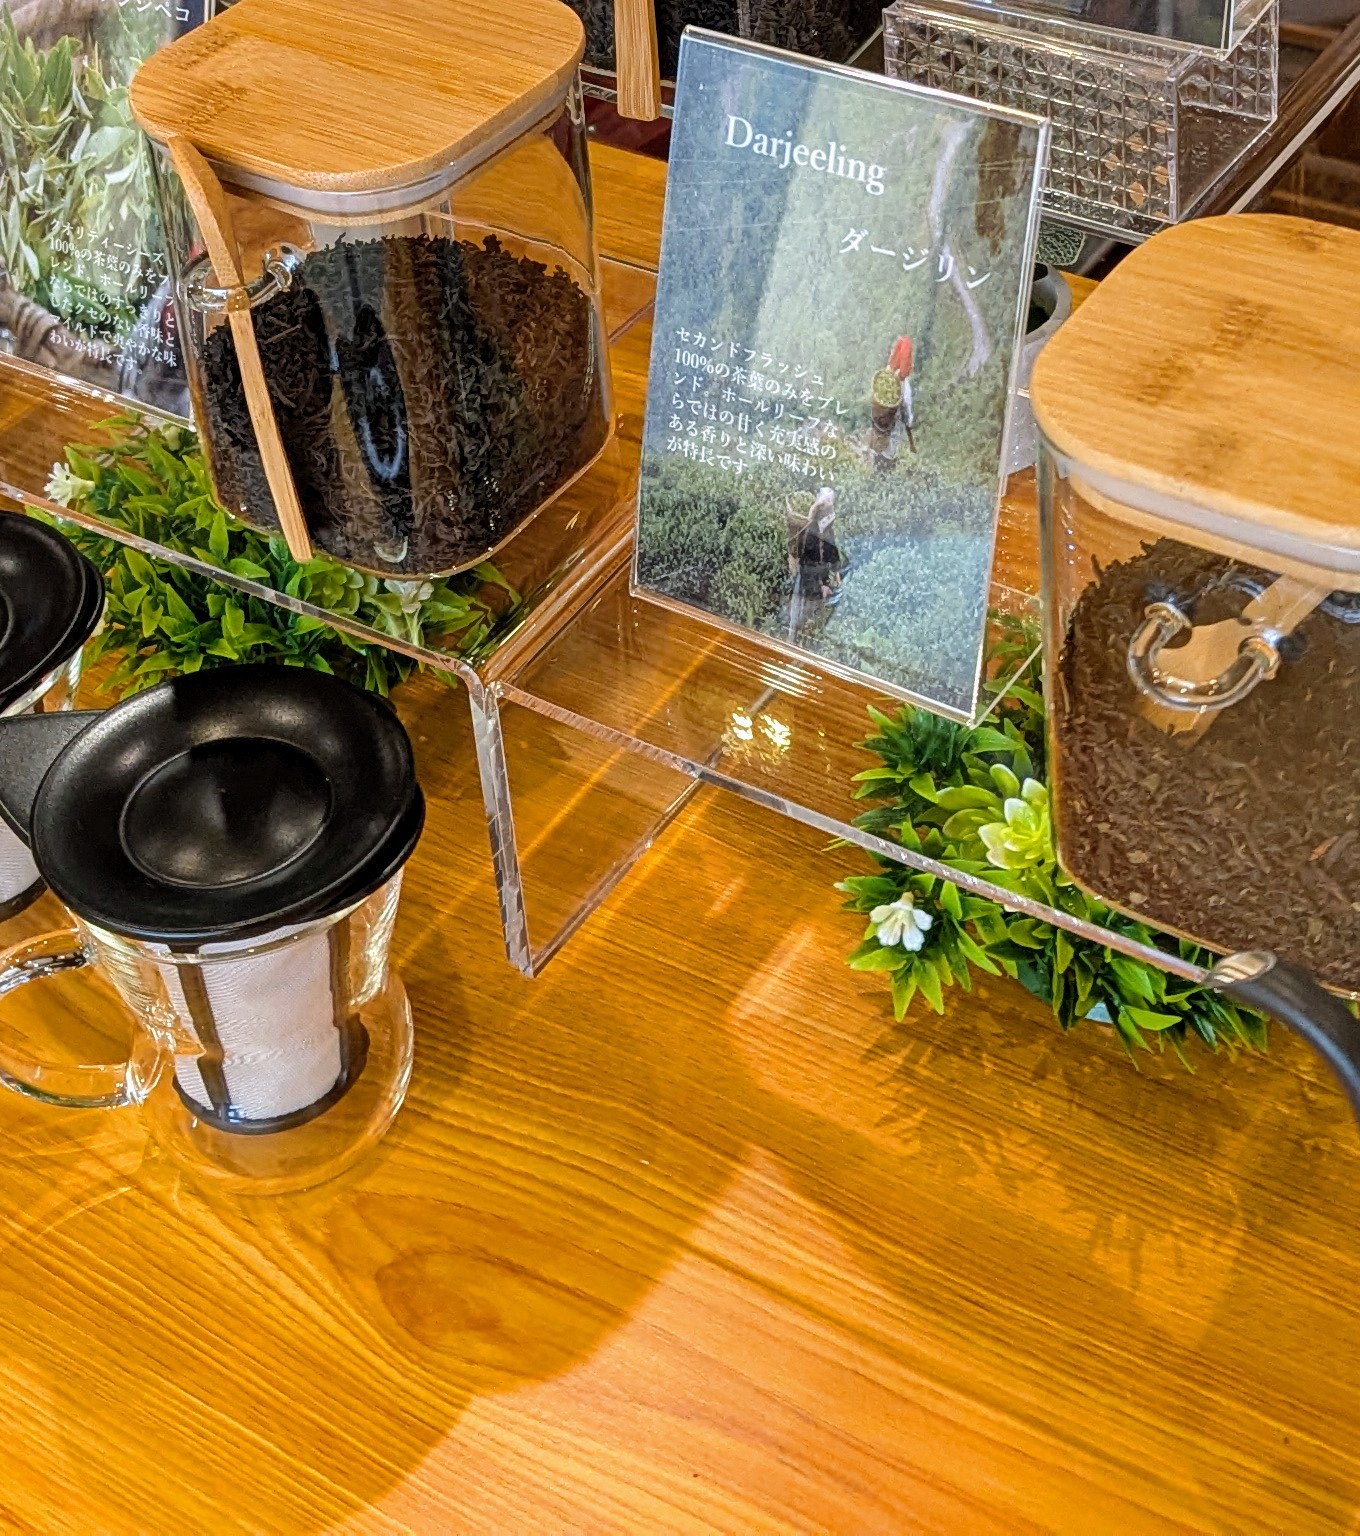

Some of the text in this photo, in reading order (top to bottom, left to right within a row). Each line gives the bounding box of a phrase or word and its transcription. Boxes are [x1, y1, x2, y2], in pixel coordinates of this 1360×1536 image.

[724, 113, 887, 196] Darjeeling
[839, 224, 992, 292] ダージリン
[49, 275, 175, 329] ならではのすっきりと
[675, 348, 850, 415] 100%の茶葉のみをブレ
[676, 326, 824, 386] セカンドフラッシュ
[667, 436, 753, 480] が特長です。
[669, 414, 834, 481] ある香りと深い味わい
[672, 392, 836, 460] らではの甘く充実感の
